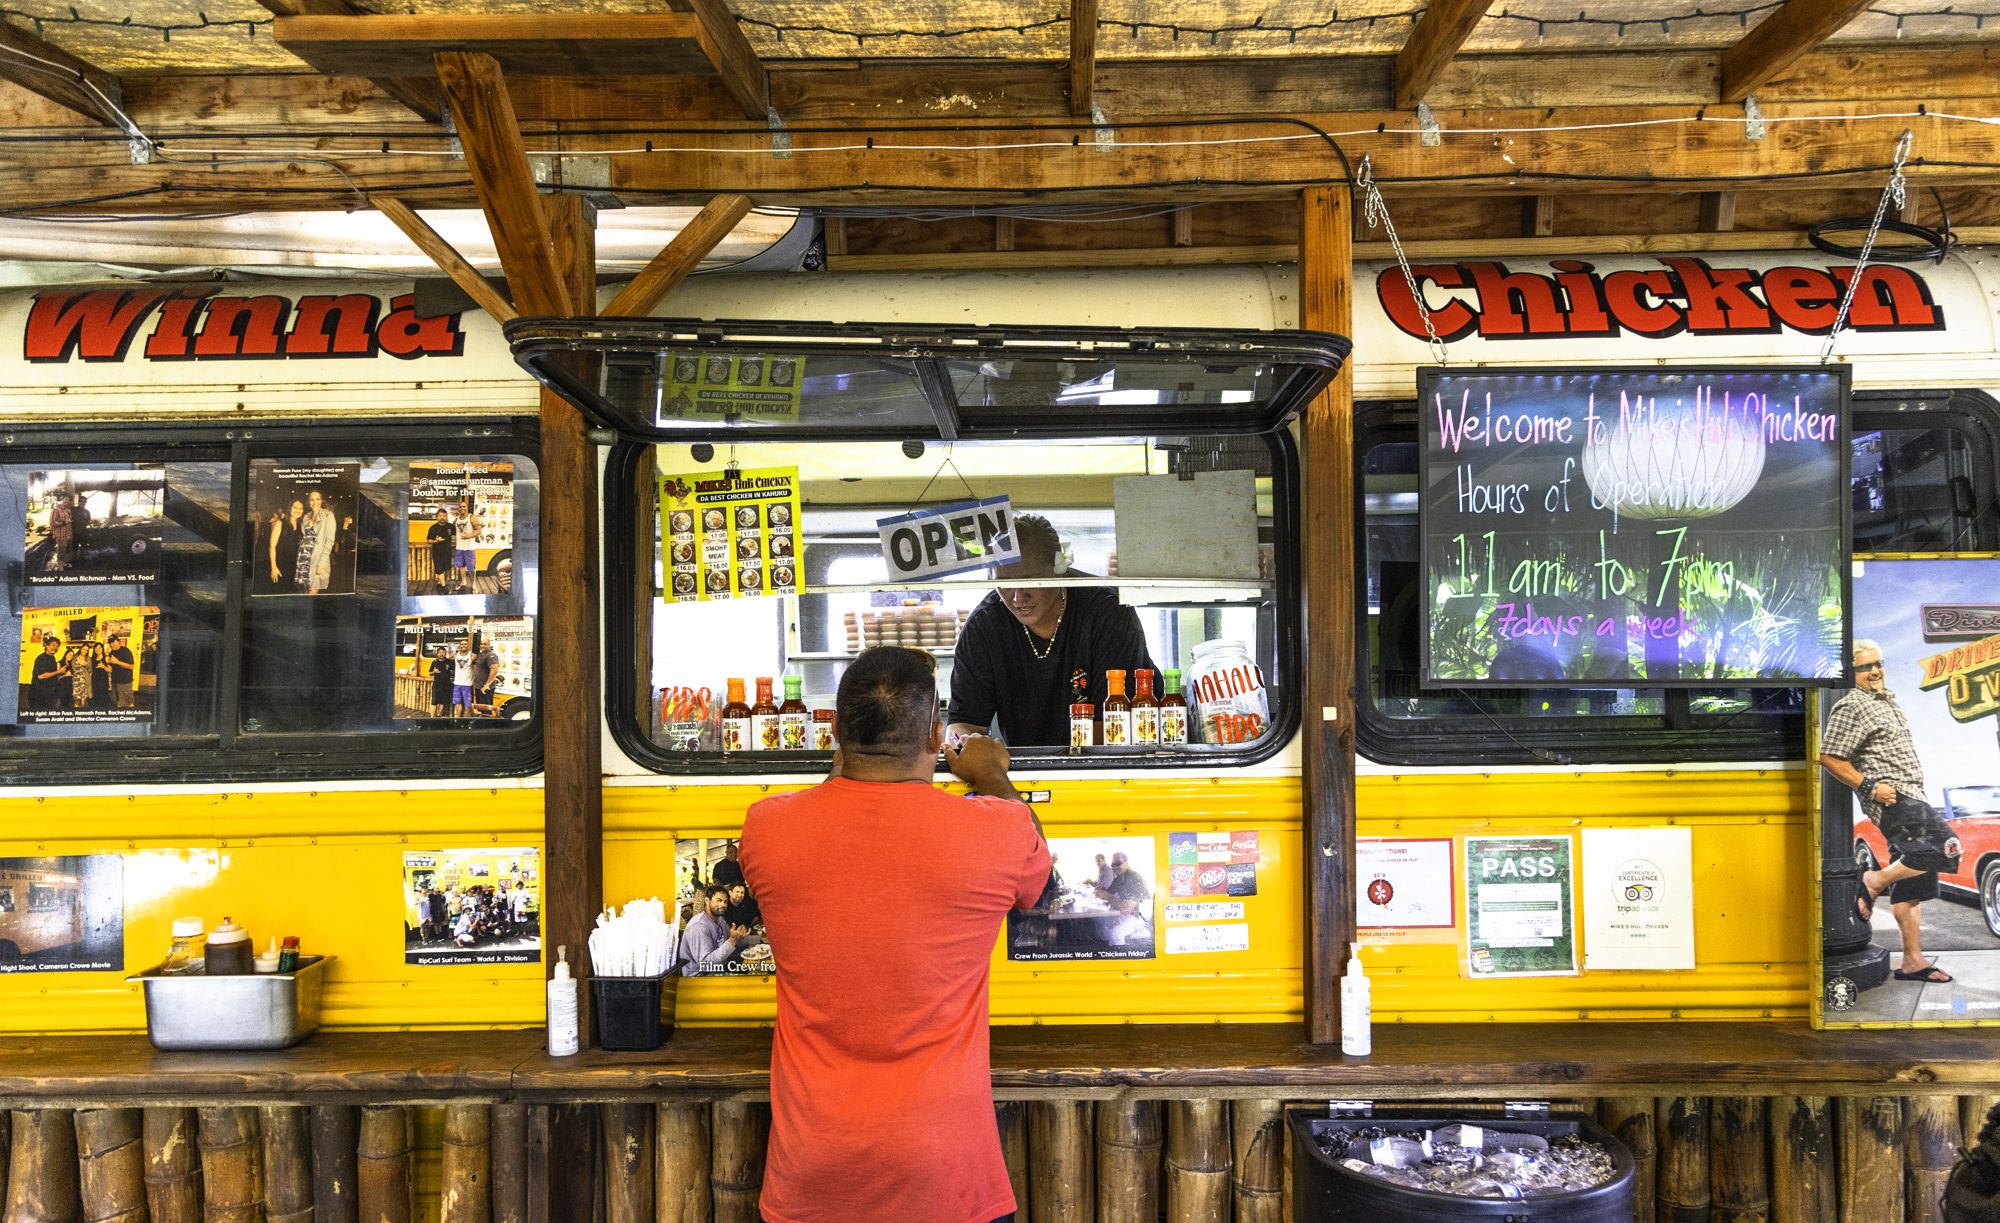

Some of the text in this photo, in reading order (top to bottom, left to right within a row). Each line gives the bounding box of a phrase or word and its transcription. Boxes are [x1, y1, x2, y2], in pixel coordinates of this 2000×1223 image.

[1376, 256, 1946, 344] Chicken
[24, 287, 465, 363] Winna
[1436, 385, 1837, 453] Welcome to Mike's Huli Chicken
[466, 466, 488, 474] Reed
[419, 478, 503, 486] @samoanstuntman
[735, 478, 754, 490] Huli
[755, 476, 792, 489] CHICKEN
[412, 489, 444, 497] Double
[446, 488, 459, 496] for
[460, 488, 474, 496] the
[727, 492, 753, 500] CHICKEN
[762, 490, 787, 498] KAHUKU
[1458, 457, 1729, 535] Hours of Operation
[890, 509, 1012, 572] OPEN
[1594, 529, 1628, 600] to
[53, 608, 83, 617] GRILLED
[404, 625, 424, 634] Miti
[432, 624, 464, 634] Future
[466, 623, 488, 634] UFC
[490, 623, 525, 635] Champ
[1596, 617, 1615, 636] a
[1629, 607, 1707, 641] week
[659, 686, 711, 722] TIPS
[1211, 713, 1261, 744] TIPS
[1208, 843, 1229, 852] Coke
[1482, 856, 1556, 878] PASS
[1617, 905, 1659, 913] tripadvisor
[1128, 950, 1150, 959] Friday"
[0, 965, 17, 973] Night
[699, 960, 776, 972] Film Crew fro
